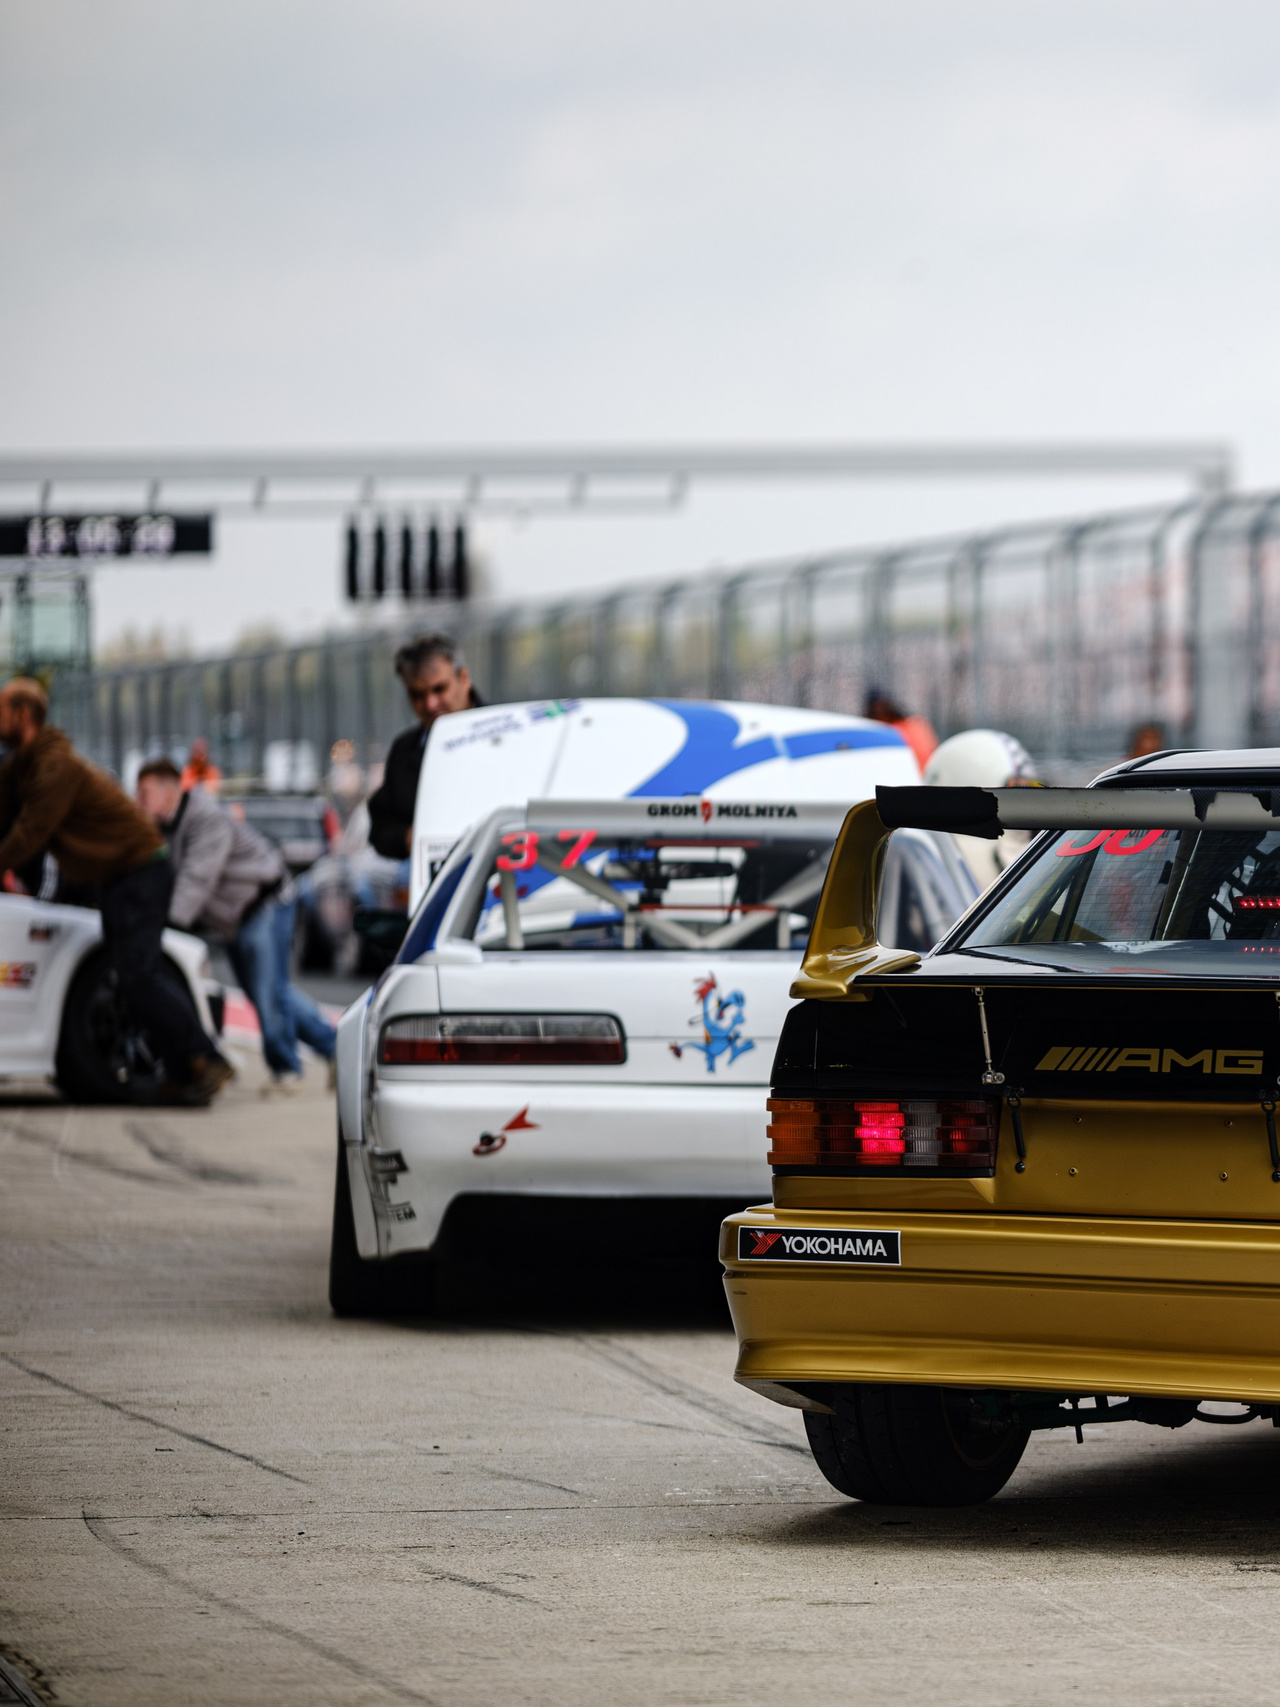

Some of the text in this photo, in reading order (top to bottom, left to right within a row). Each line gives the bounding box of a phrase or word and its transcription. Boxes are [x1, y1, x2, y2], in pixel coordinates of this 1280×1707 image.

[648, 802, 798, 818] GROM MOLNIYA
[496, 830, 599, 870] 37
[1105, 1047, 1264, 1075] AMG
[781, 1235, 888, 1257] YOKOHAMA
